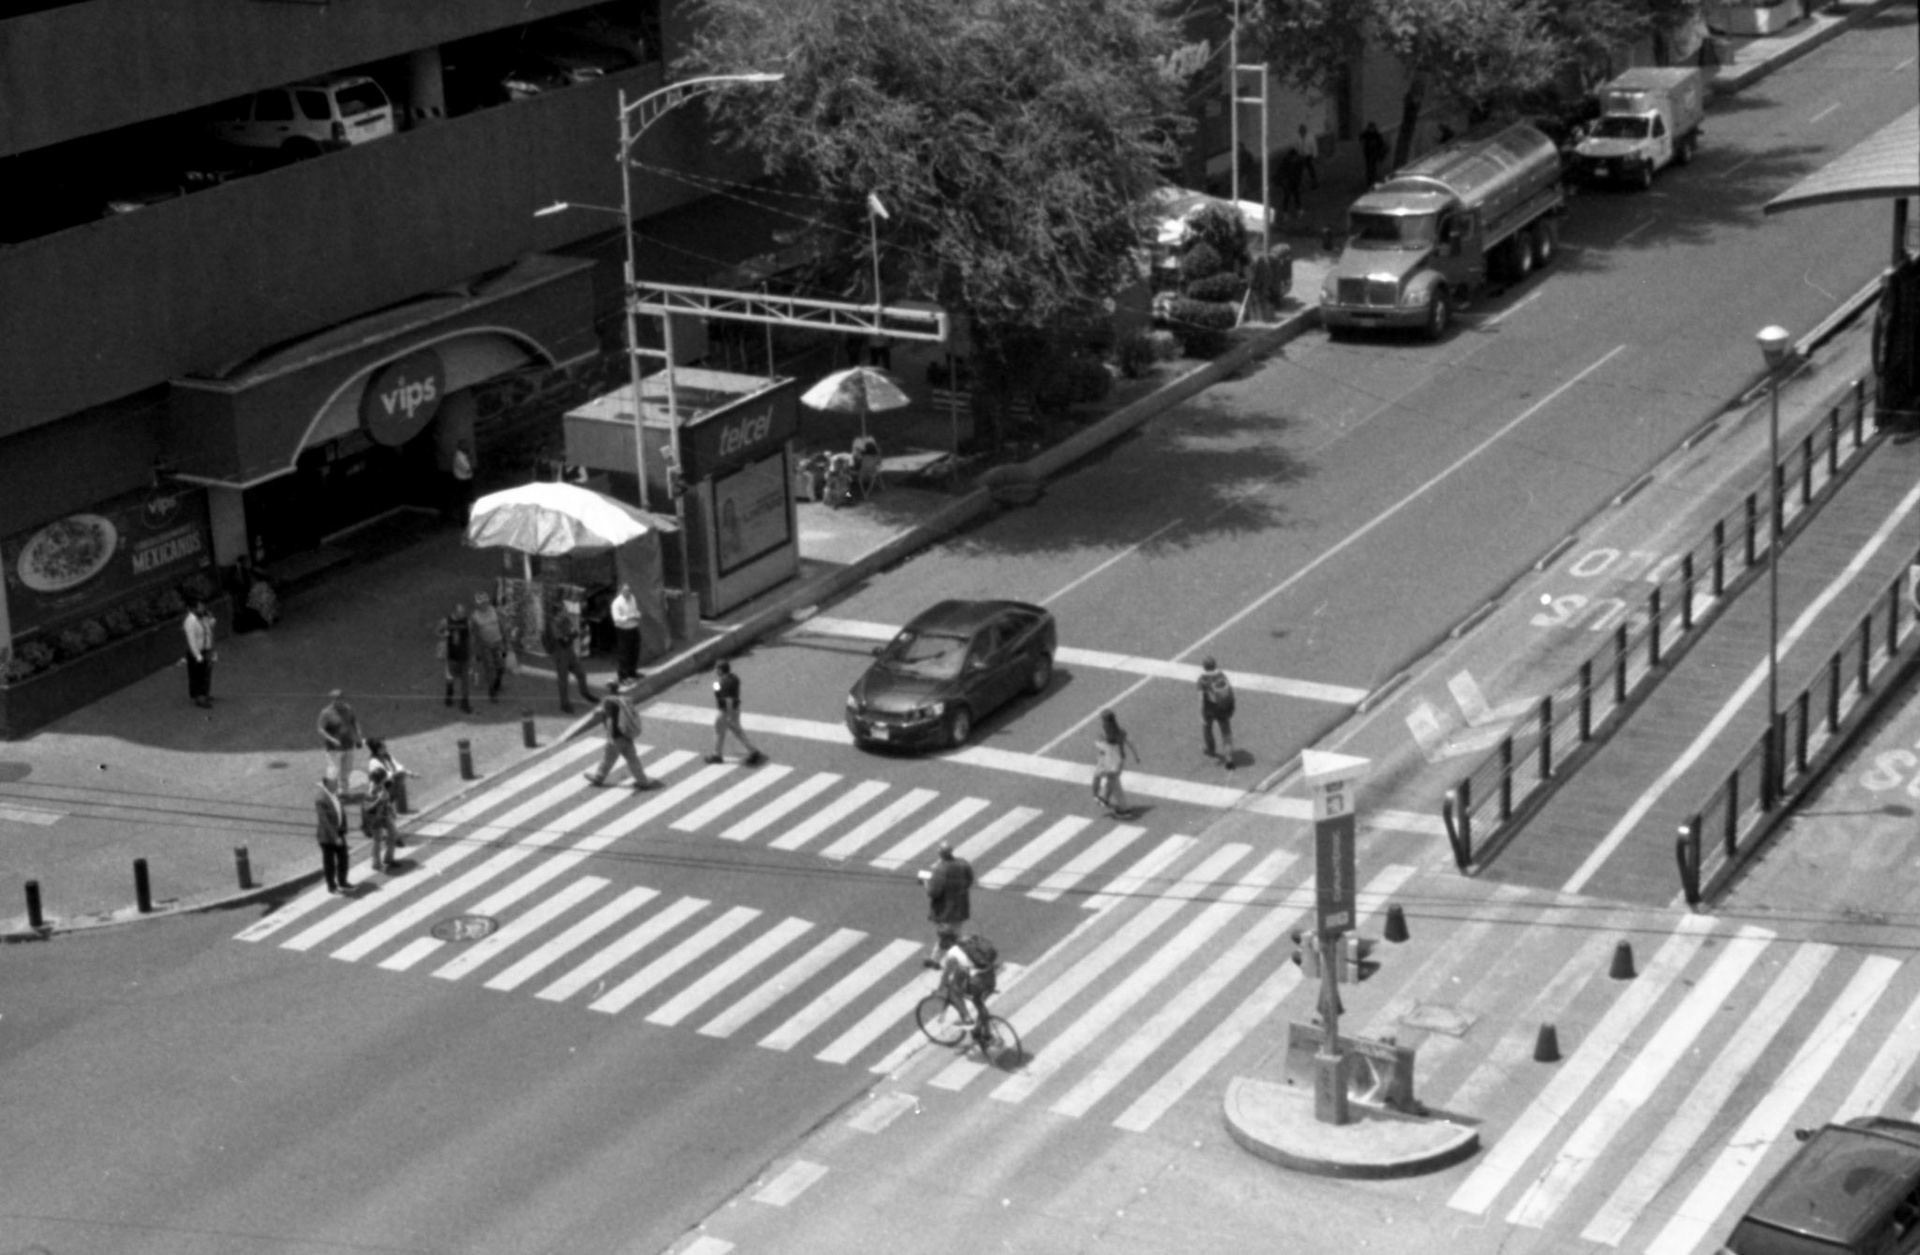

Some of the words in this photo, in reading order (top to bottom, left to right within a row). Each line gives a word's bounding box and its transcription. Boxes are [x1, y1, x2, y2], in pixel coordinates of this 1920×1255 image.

[380, 375, 437, 419] vips
[719, 404, 774, 457] telcel
[132, 530, 202, 575] MEXICANOS
